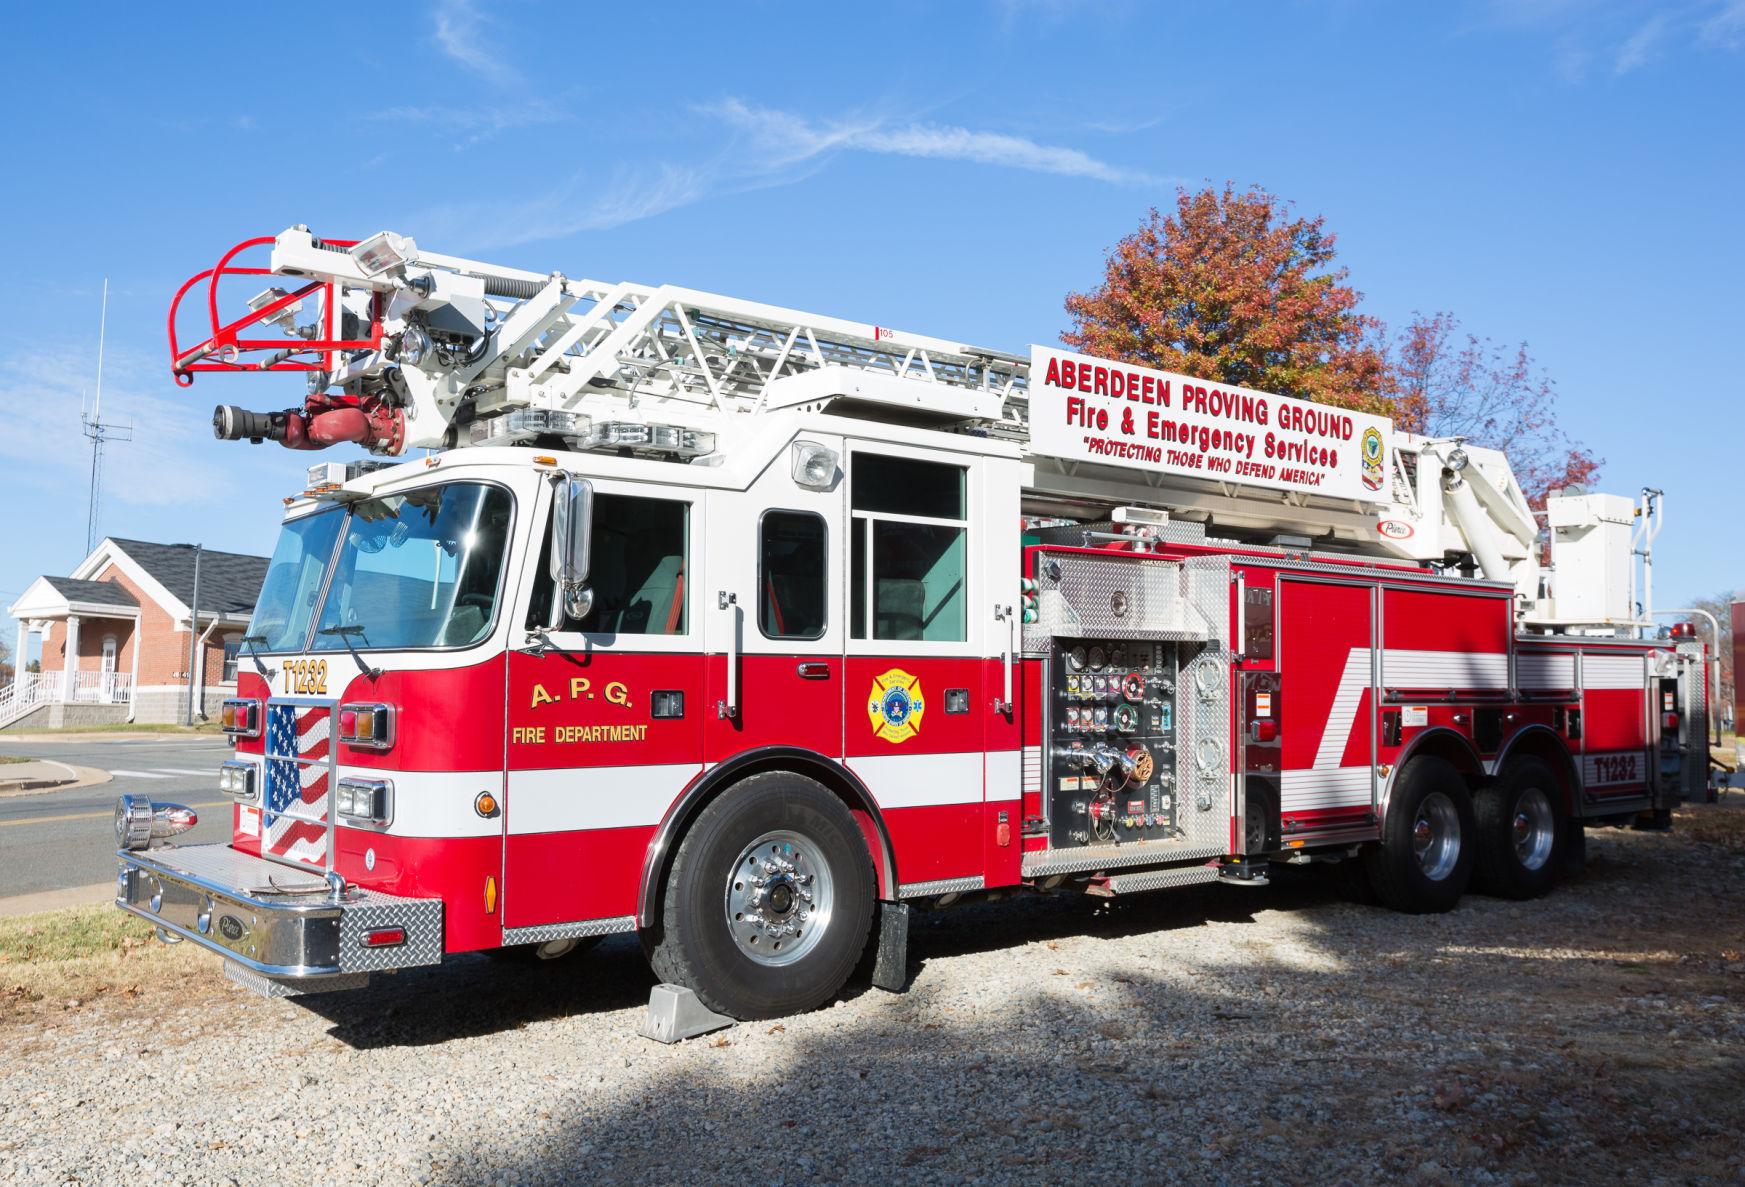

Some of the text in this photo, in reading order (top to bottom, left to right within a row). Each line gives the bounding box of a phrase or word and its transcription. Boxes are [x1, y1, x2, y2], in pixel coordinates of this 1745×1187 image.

[880, 328, 894, 338] 105
[1045, 357, 1354, 441] ABERDEEN PROVING GROUND
[1067, 396, 1109, 430] Fire
[1121, 406, 1136, 435] &
[1147, 410, 1256, 459] Emergency
[1264, 431, 1338, 468] Services
[1167, 449, 1204, 469] THOSE
[1207, 456, 1232, 473] WHO
[1235, 459, 1277, 479] DEFEND
[283, 659, 328, 695] T1232
[530, 677, 633, 709] A. P. G.
[512, 725, 648, 745] FIRE DEPARTMENT
[1593, 754, 1637, 783] T1232
